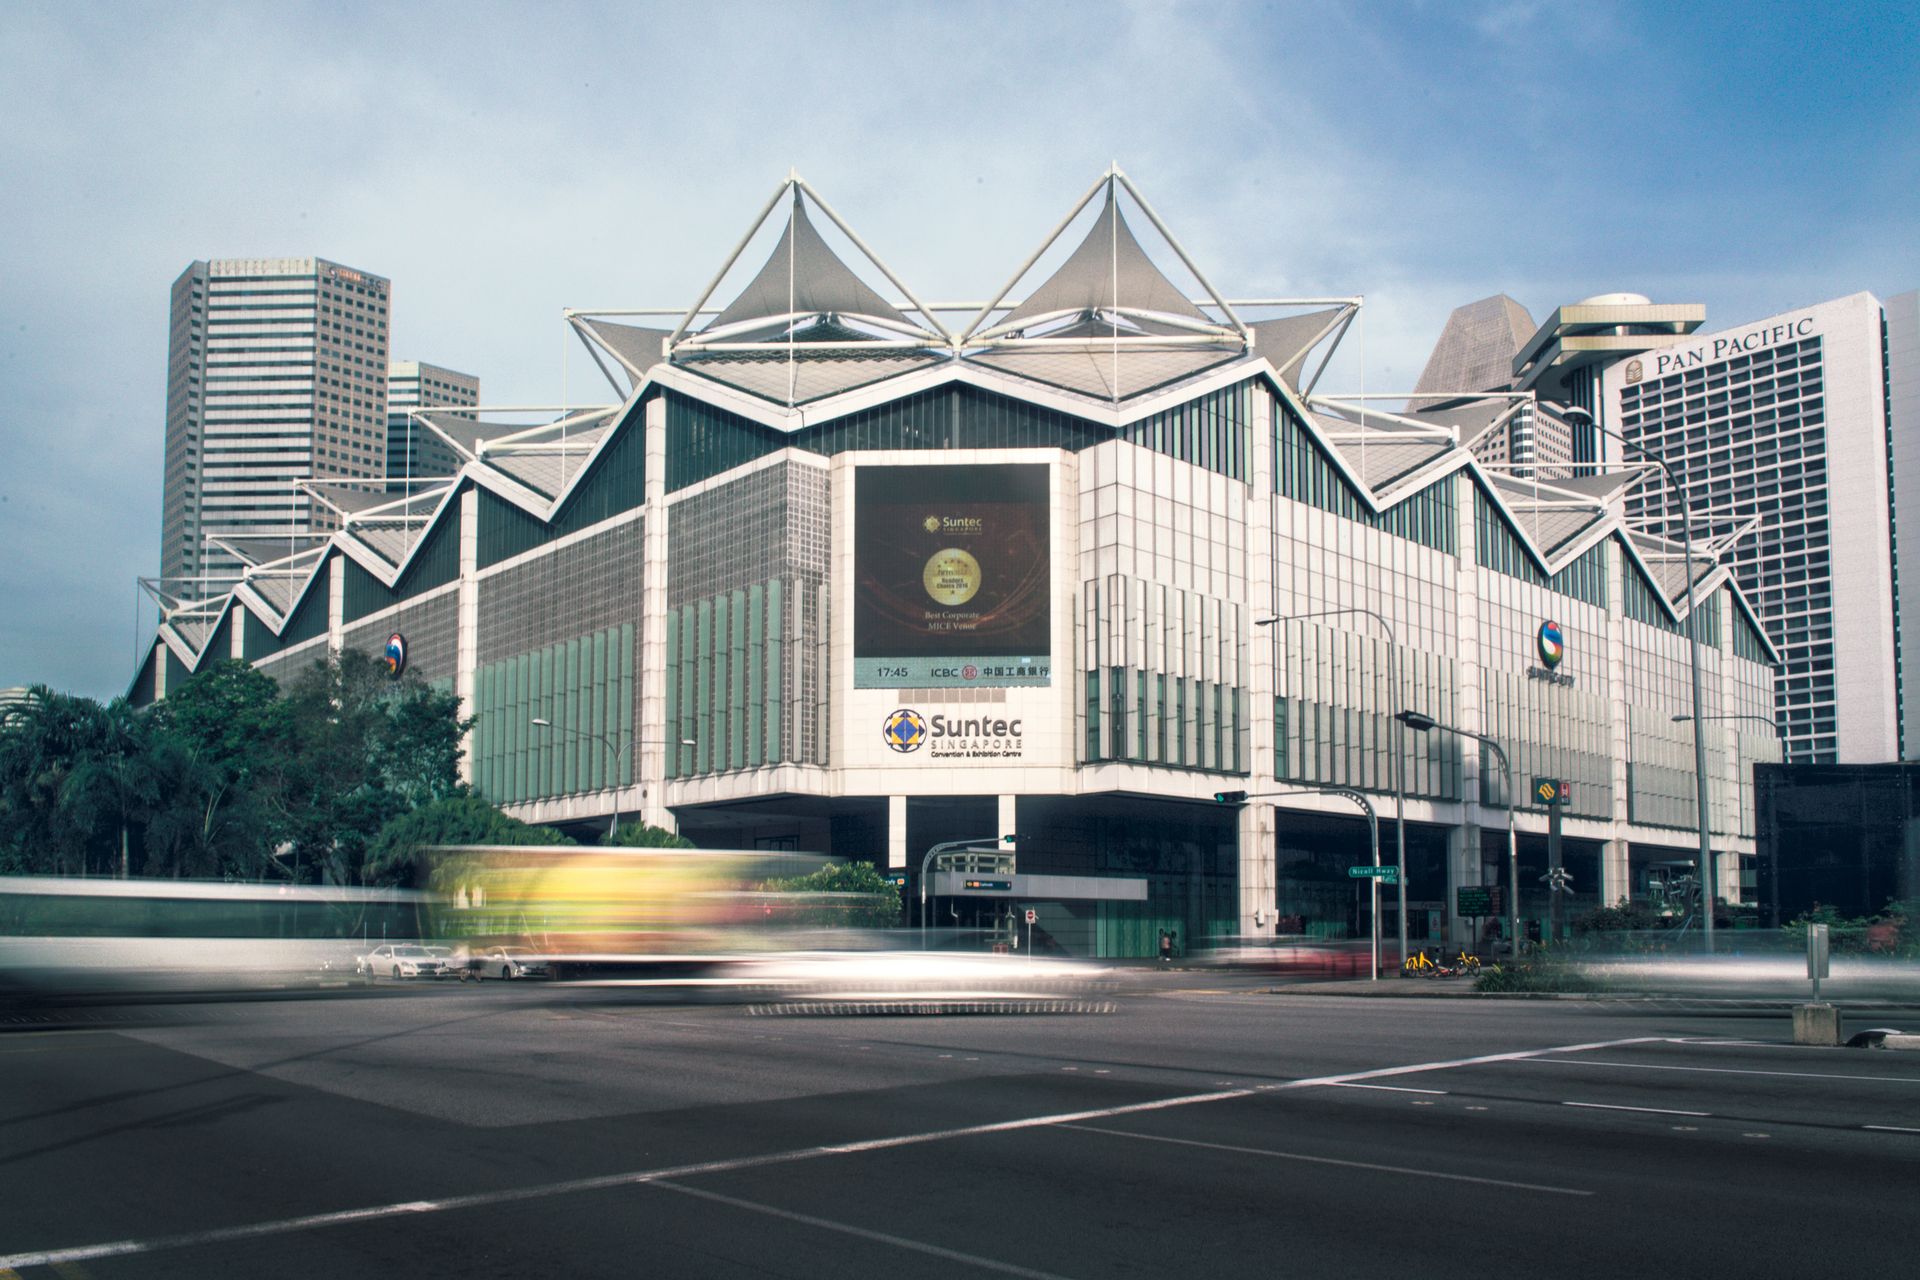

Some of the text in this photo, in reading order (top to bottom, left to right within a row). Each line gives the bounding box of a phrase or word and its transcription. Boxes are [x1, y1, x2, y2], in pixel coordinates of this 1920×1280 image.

[1657, 318, 1813, 375] PAN PACIFIC
[943, 516, 982, 527] Suntec
[925, 611, 980, 621] Best Corporate
[877, 668, 908, 677] 17:45
[931, 668, 958, 677] ICBC
[930, 714, 1022, 738] Suntec
[930, 739, 1022, 750] SINGAPORE
[1002, 750, 1022, 758] Centre
